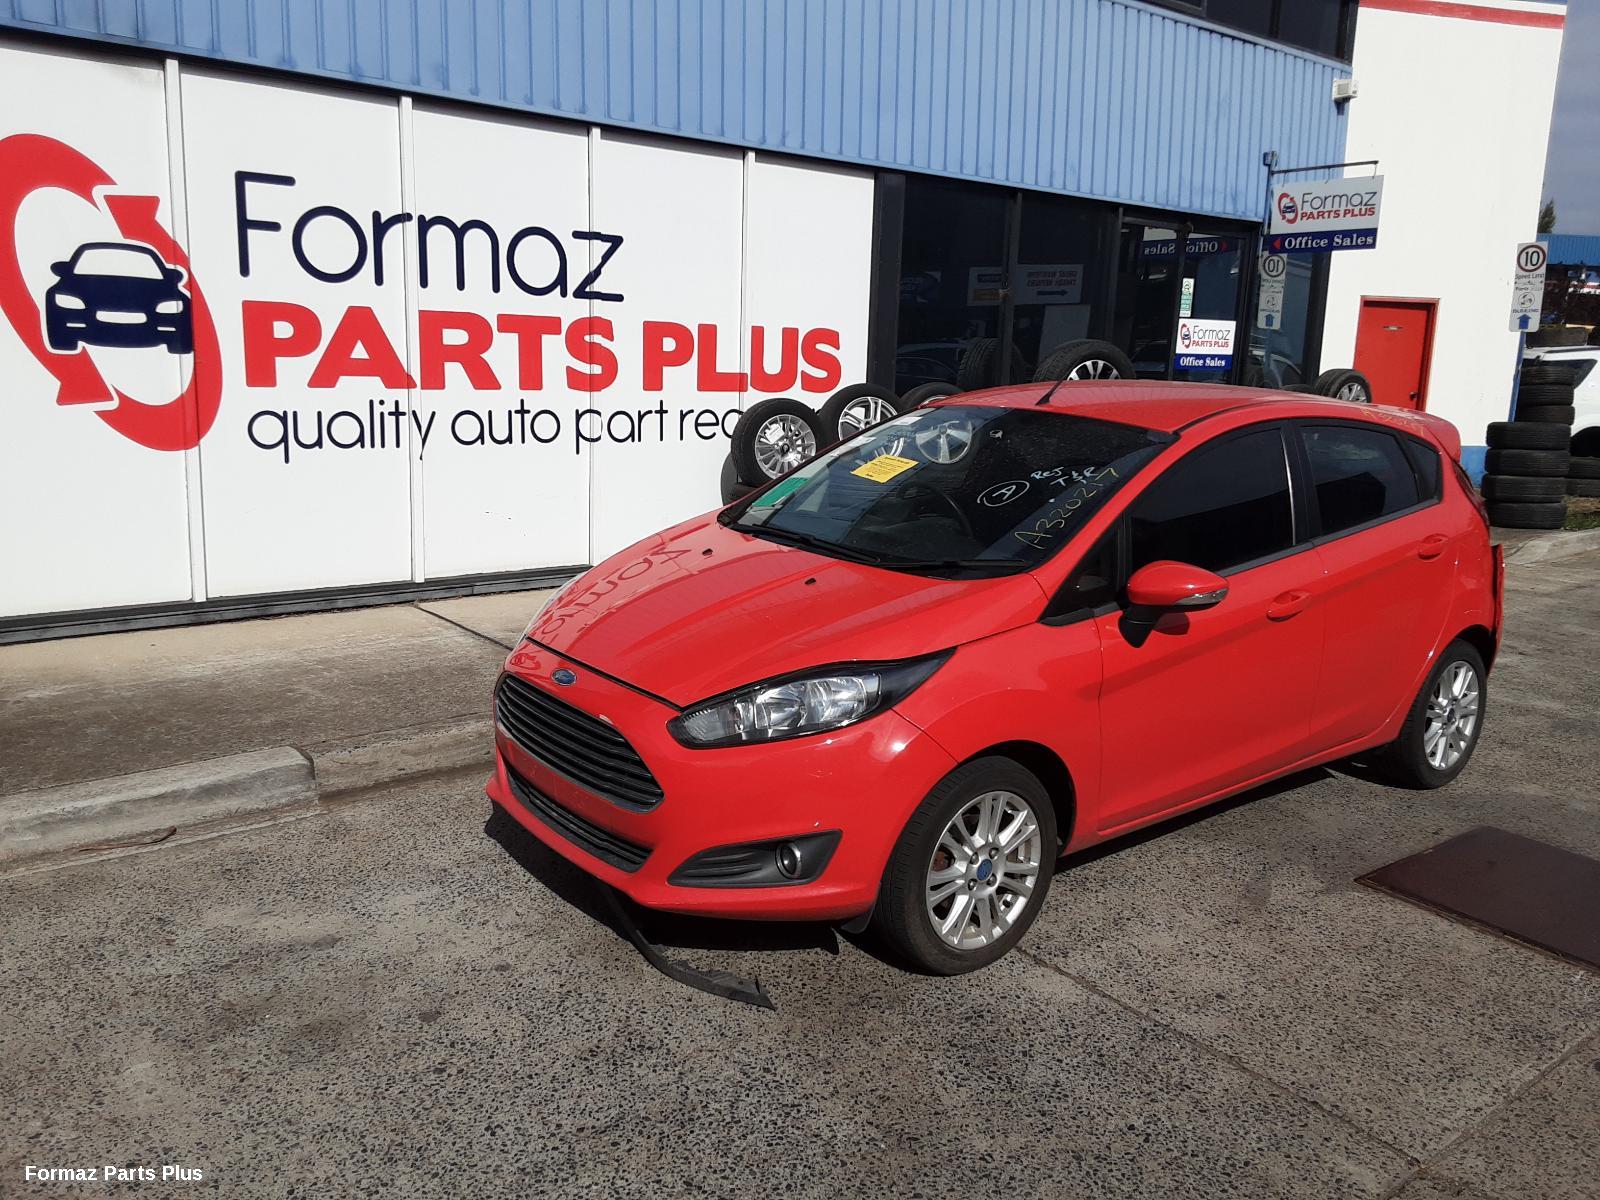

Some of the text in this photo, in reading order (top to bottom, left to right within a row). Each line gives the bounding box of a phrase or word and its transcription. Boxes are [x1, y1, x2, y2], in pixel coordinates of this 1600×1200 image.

[1301, 191, 1377, 211] Formaz
[1300, 207, 1375, 221] PARTS PLUS
[235, 170, 624, 302] Formaz
[1285, 233, 1373, 249] Office Sales
[1525, 250, 1540, 267] 10
[1192, 325, 1230, 341] Formaz
[242, 300, 841, 393] PARTS PLUS
[1180, 356, 1226, 367] Office Sales
[247, 399, 745, 464] quality auto part rec
